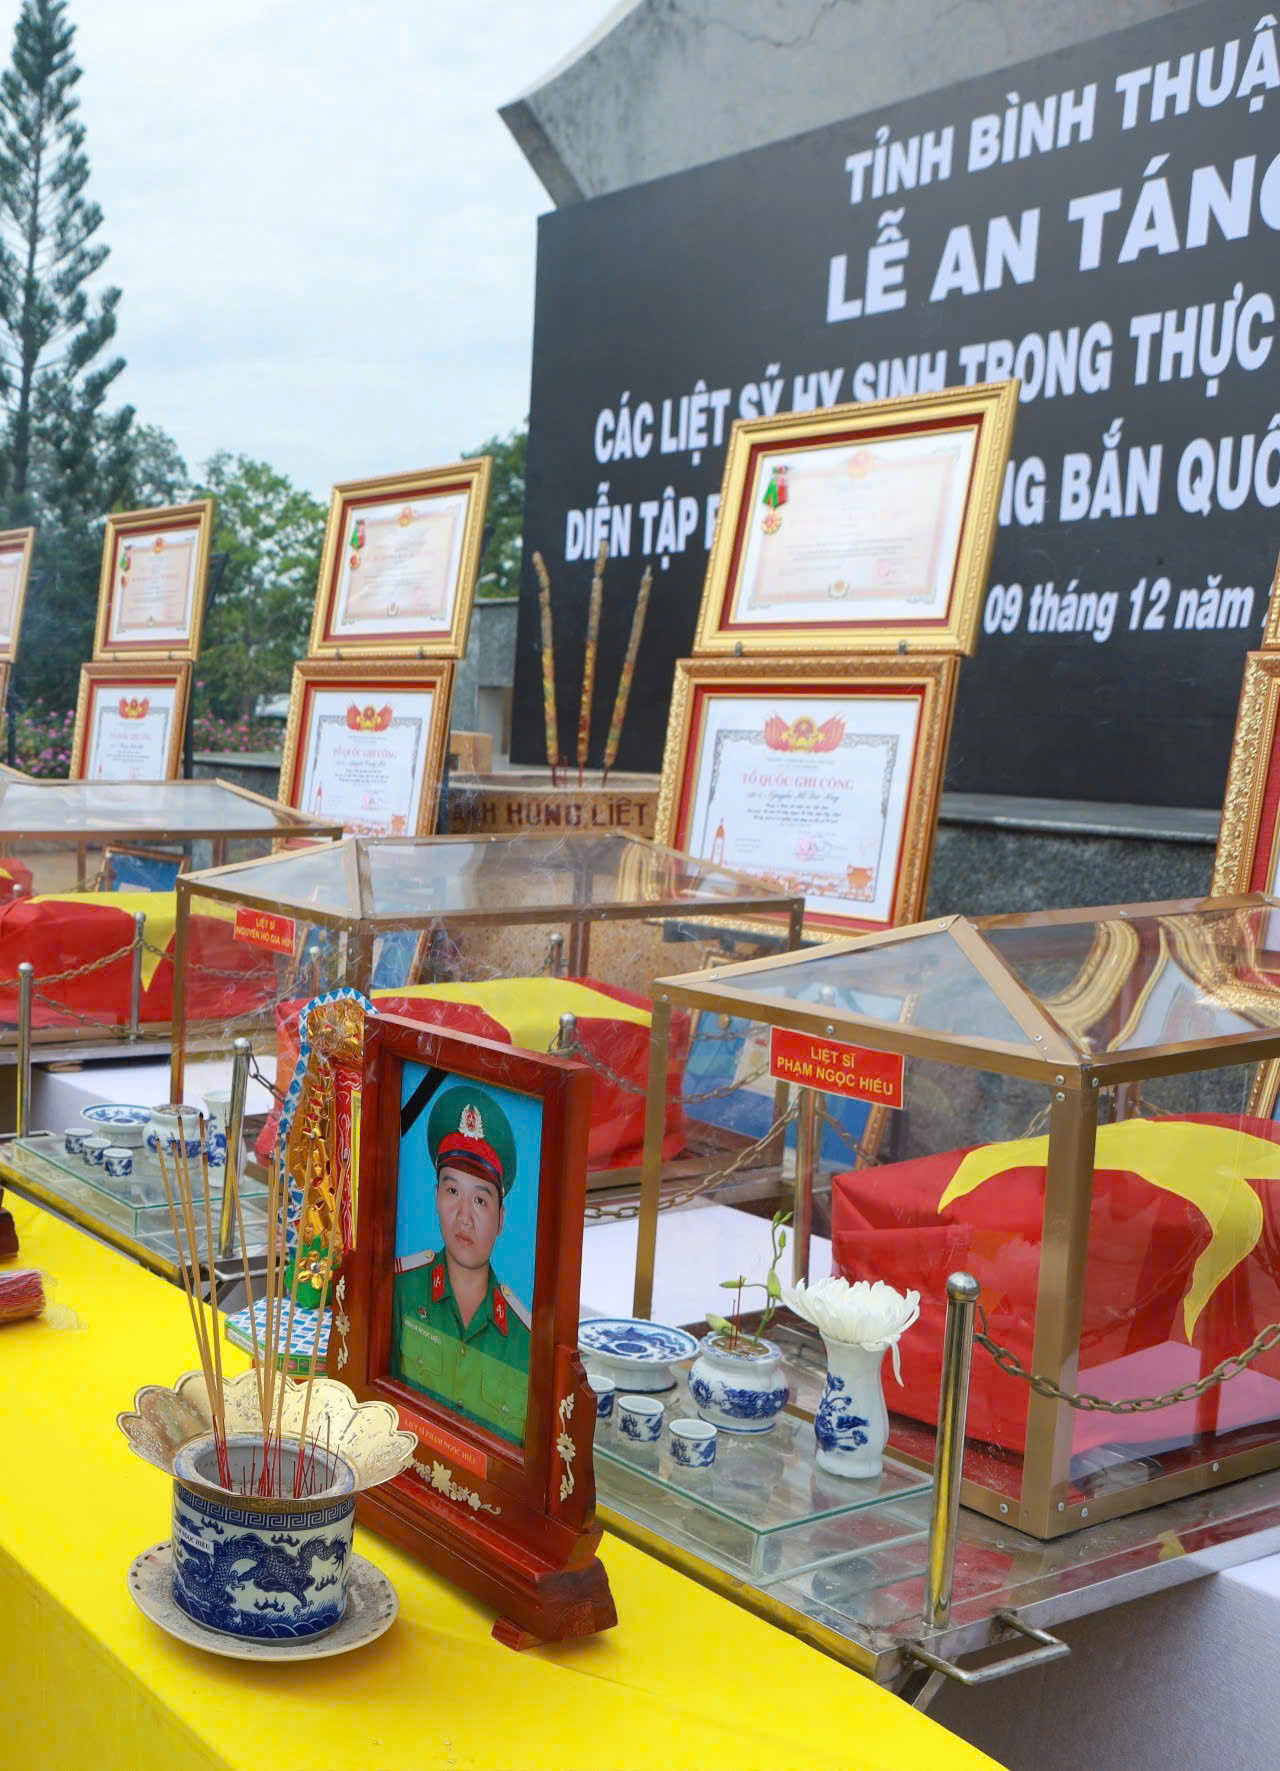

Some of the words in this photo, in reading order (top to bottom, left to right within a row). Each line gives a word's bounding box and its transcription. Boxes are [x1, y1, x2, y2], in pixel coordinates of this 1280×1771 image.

[845, 124, 955, 206] TỈNH
[967, 91, 1099, 173] BÌNH
[826, 206, 910, 324] LỄ
[929, 207, 1041, 302] AN
[594, 390, 655, 464] CÁC
[660, 379, 732, 467] LIỆT
[738, 362, 785, 420] SỸ
[792, 368, 845, 412] HY
[853, 350, 948, 402] SINH
[959, 320, 1114, 403] TRONG
[1129, 281, 1276, 398] THỰC
[565, 481, 633, 561] DIỄN
[639, 485, 699, 571] TẬP
[1059, 417, 1163, 522] BẮN
[983, 583, 1023, 635] 09
[1027, 579, 1119, 644] tháng
[1129, 577, 1171, 631] 12
[1173, 574, 1255, 630] năm
[777, 1056, 813, 1077] PHẠM
[816, 1066, 856, 1087] NGỌC
